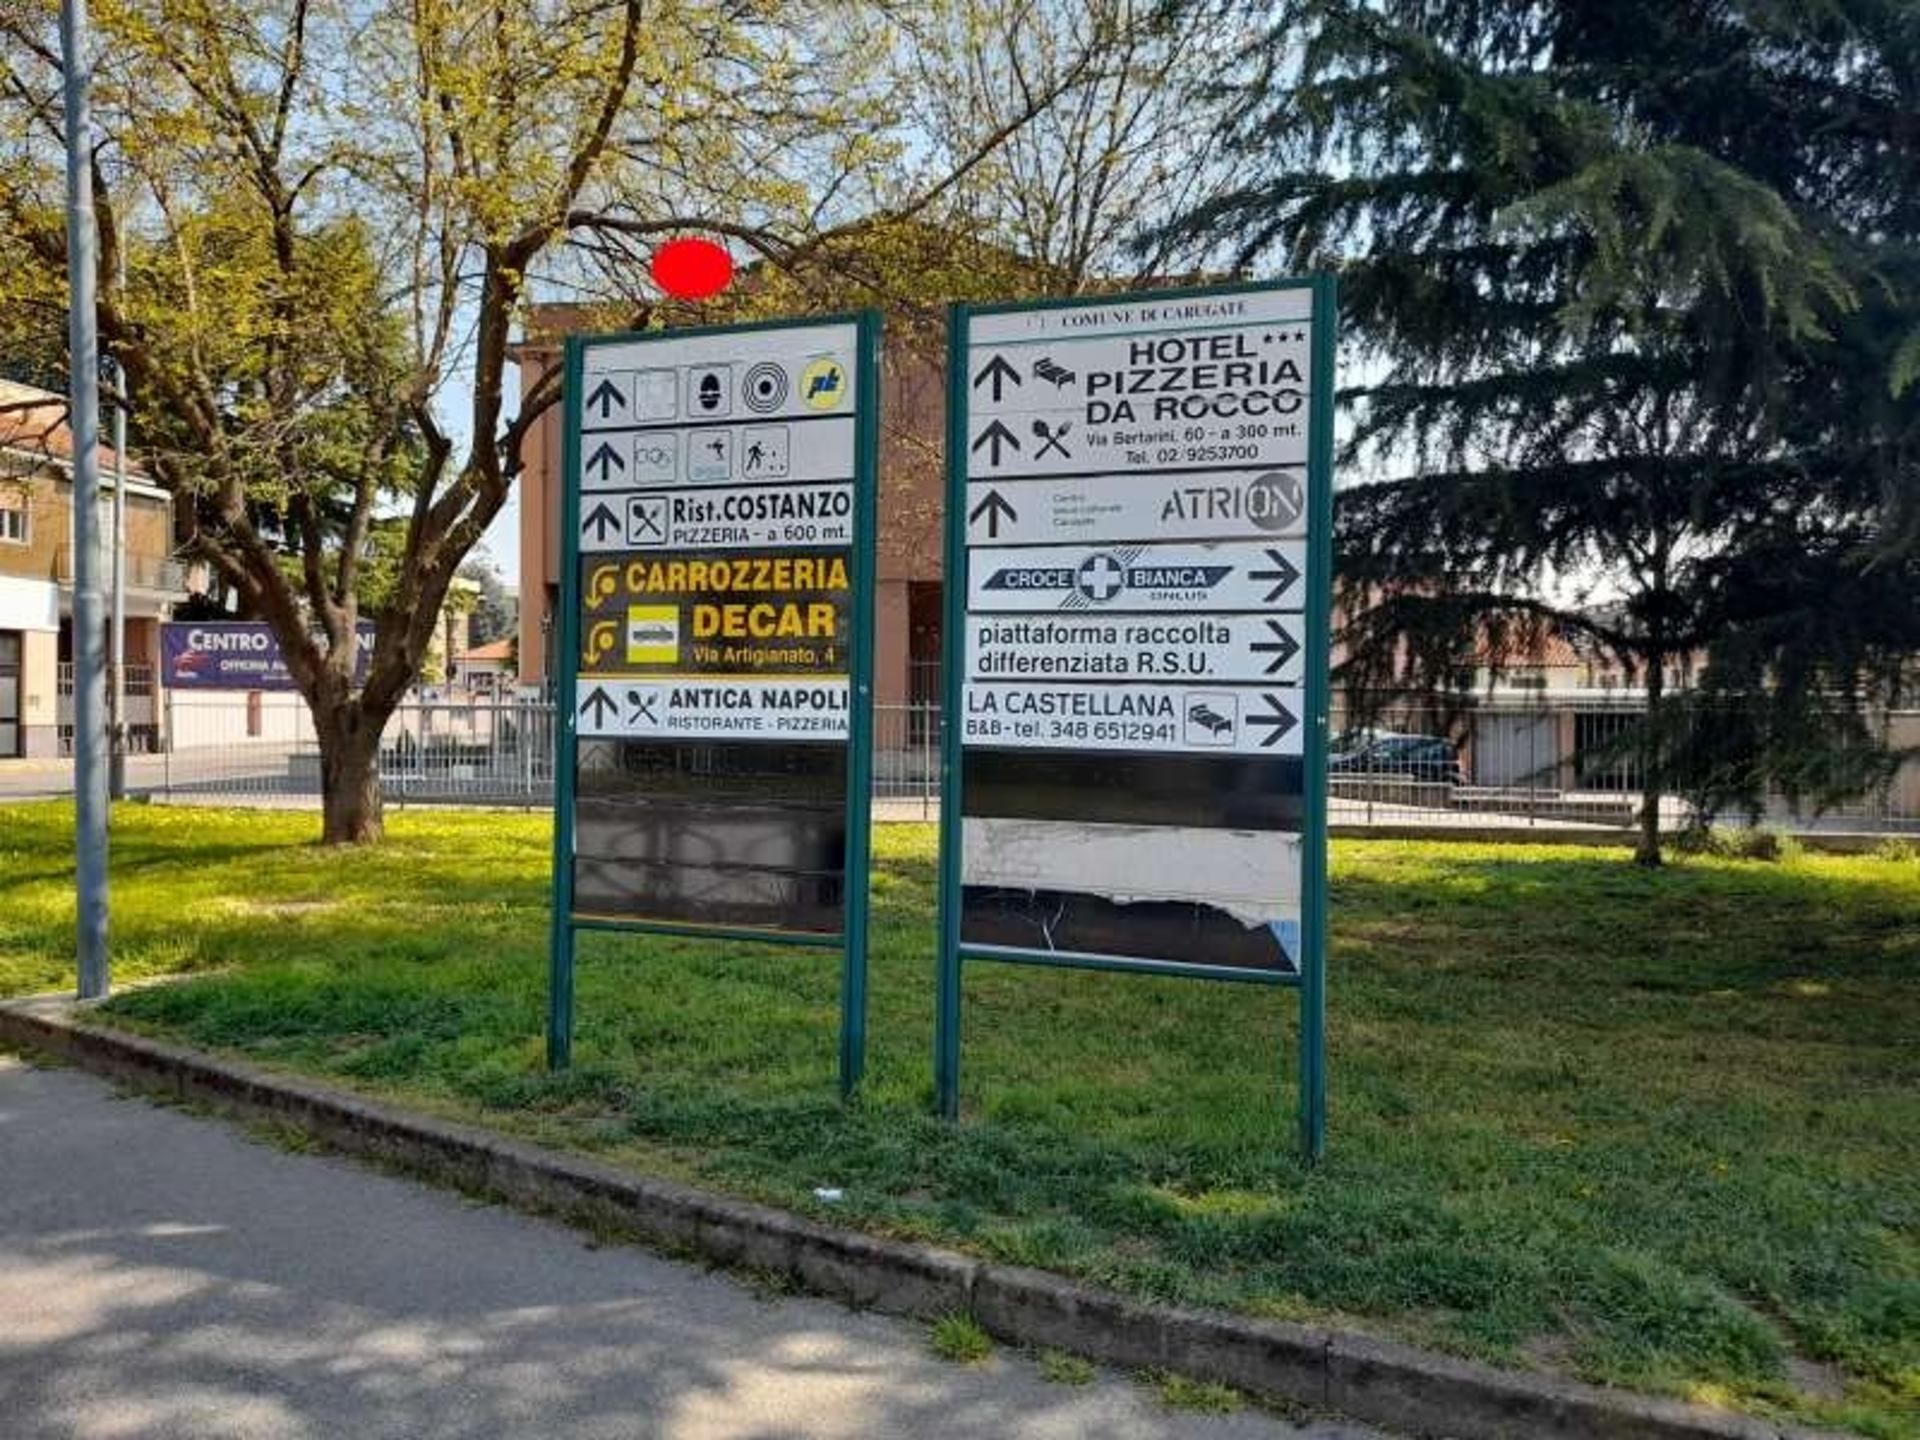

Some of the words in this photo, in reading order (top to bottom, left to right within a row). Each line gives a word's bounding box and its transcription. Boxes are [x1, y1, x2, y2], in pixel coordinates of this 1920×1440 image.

[1062, 311, 1135, 327] COMUNE
[1141, 309, 1157, 321] DI
[1163, 301, 1244, 320] CARUGATE
[1130, 334, 1258, 365] HOTEL
[1087, 360, 1304, 397] PIZZERIA
[1087, 400, 1136, 425] DA
[1154, 388, 1302, 421] ROCCO
[1086, 432, 1108, 446] Via
[1184, 426, 1205, 441] 60
[1221, 429, 1230, 440] a
[1235, 424, 1268, 439] 300
[1126, 450, 1150, 464] Tel.
[1187, 444, 1259, 461] 9253700
[673, 491, 851, 525] Rist.COSTANZO
[1161, 484, 1300, 520] ATRION
[673, 527, 750, 544] PIZZERIA
[767, 529, 777, 541] a
[784, 525, 817, 541] 600
[626, 558, 849, 593] CARROZZERIA
[1004, 571, 1074, 588] CROCE
[1134, 569, 1207, 587] BIANCA
[692, 603, 836, 638] DECAR
[188, 629, 269, 651] CENTRO
[977, 623, 1118, 648] piattaforma
[1125, 621, 1231, 645] raccolta
[694, 648, 719, 663] Via
[723, 646, 820, 667] Artigianato,
[977, 652, 1129, 674] differenziata
[1136, 653, 1214, 675] R.S.U.
[668, 688, 753, 710] ANTICA
[761, 689, 848, 711] NAPOLI
[967, 691, 998, 714] LA
[1004, 692, 1176, 718] CASTELLANA
[667, 716, 763, 731] RISTORANTE
[776, 716, 848, 732] PIZZERIA
[1051, 720, 1089, 738] 348
[1094, 721, 1176, 742] 6512941
